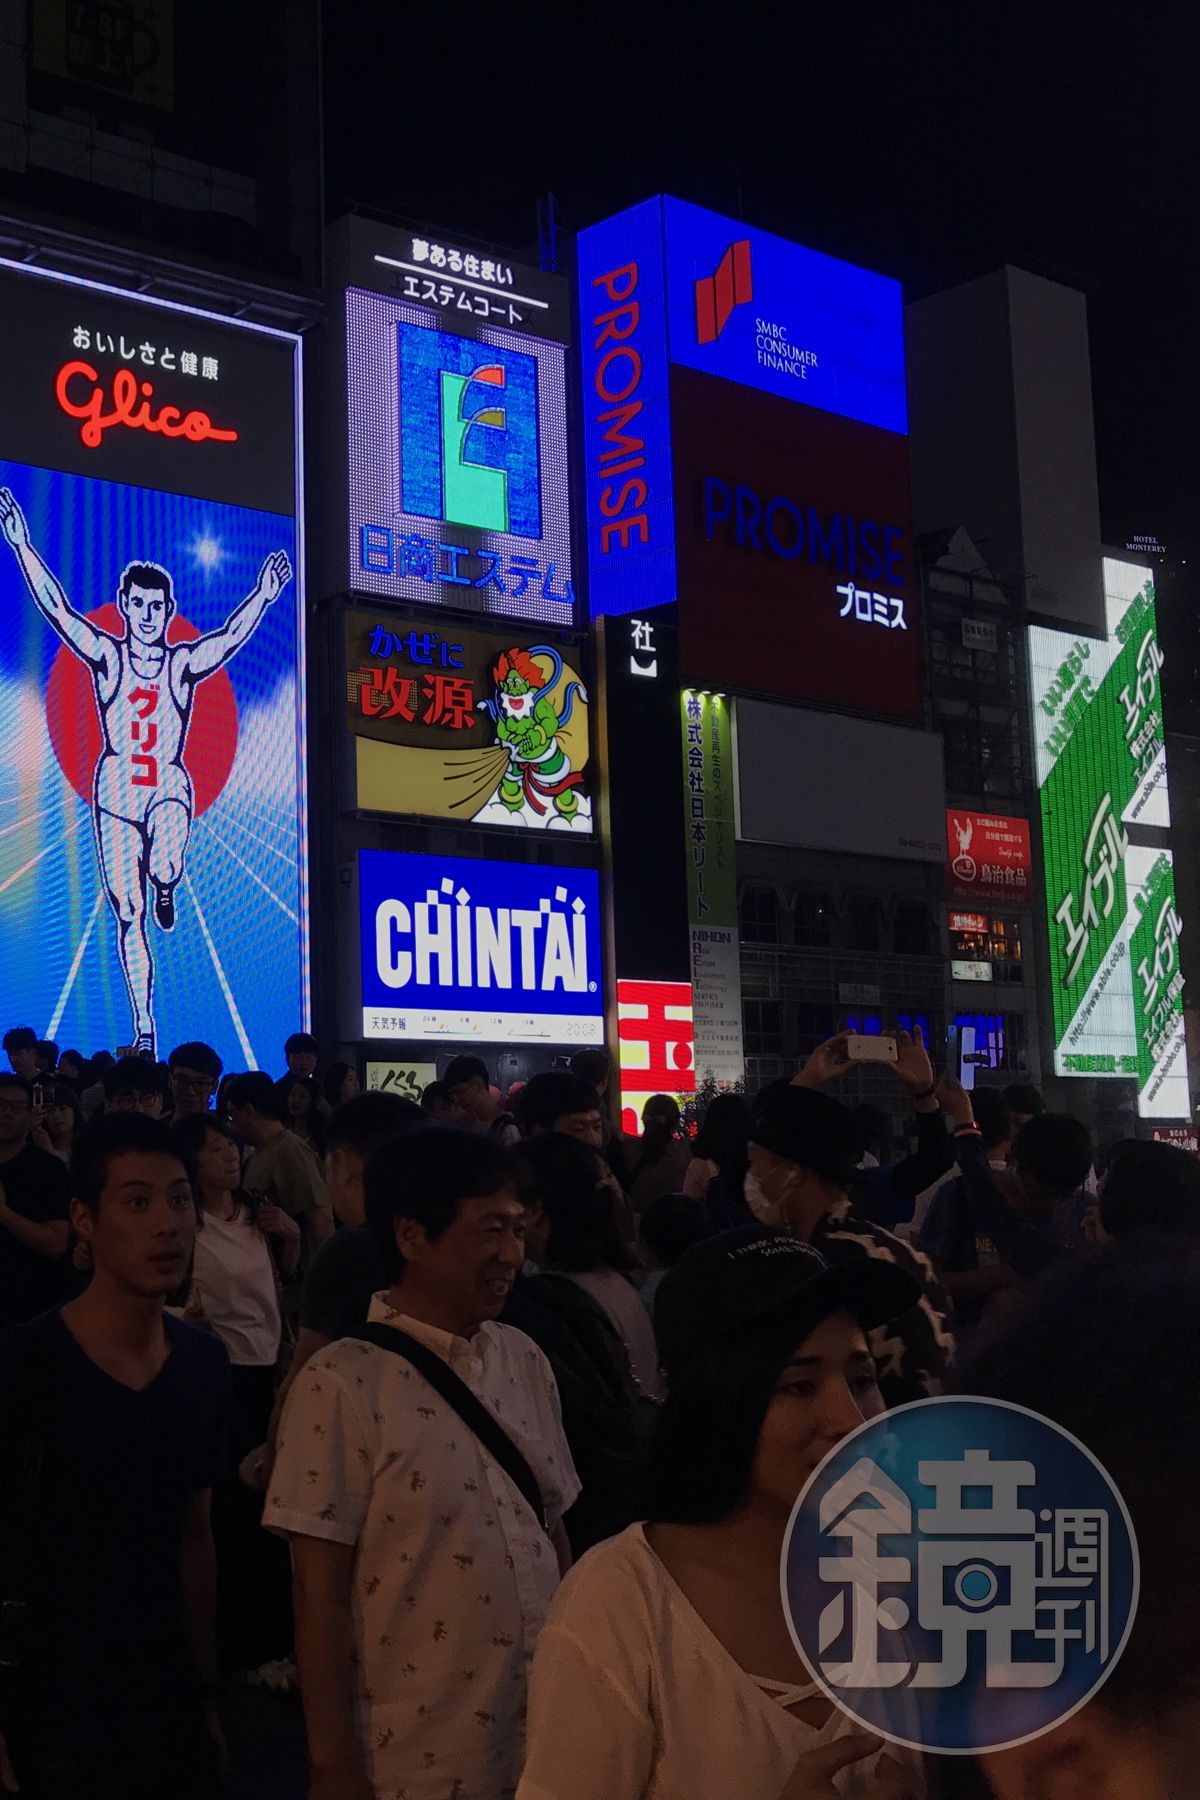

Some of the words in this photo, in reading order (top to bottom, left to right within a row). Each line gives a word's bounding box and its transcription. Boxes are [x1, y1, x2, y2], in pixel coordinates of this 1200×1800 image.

[411, 238, 513, 285] 夢ある住まい
[403, 275, 523, 324] エステムコート
[72, 325, 219, 381] おいしさと健康
[755, 318, 788, 342] SMBC
[755, 334, 819, 368] CONSUMER
[757, 350, 808, 380] FINANCE
[590, 260, 650, 555] PROMISE
[704, 475, 906, 586] PROMISE
[1126, 542, 1167, 554] MONTEREY
[1133, 535, 1158, 545] HOTEL
[361, 523, 577, 604] 日商エステム
[835, 580, 909, 631] プロミス
[367, 624, 466, 669] かぜに
[359, 665, 477, 731] 改源
[1118, 638, 1165, 725] エイブル
[127, 683, 161, 788] グリコ
[687, 698, 709, 919] 株式会社日本リート
[1054, 812, 1130, 958] エイブル
[692, 930, 731, 943] NIHON
[1137, 906, 1184, 997] エイブル
